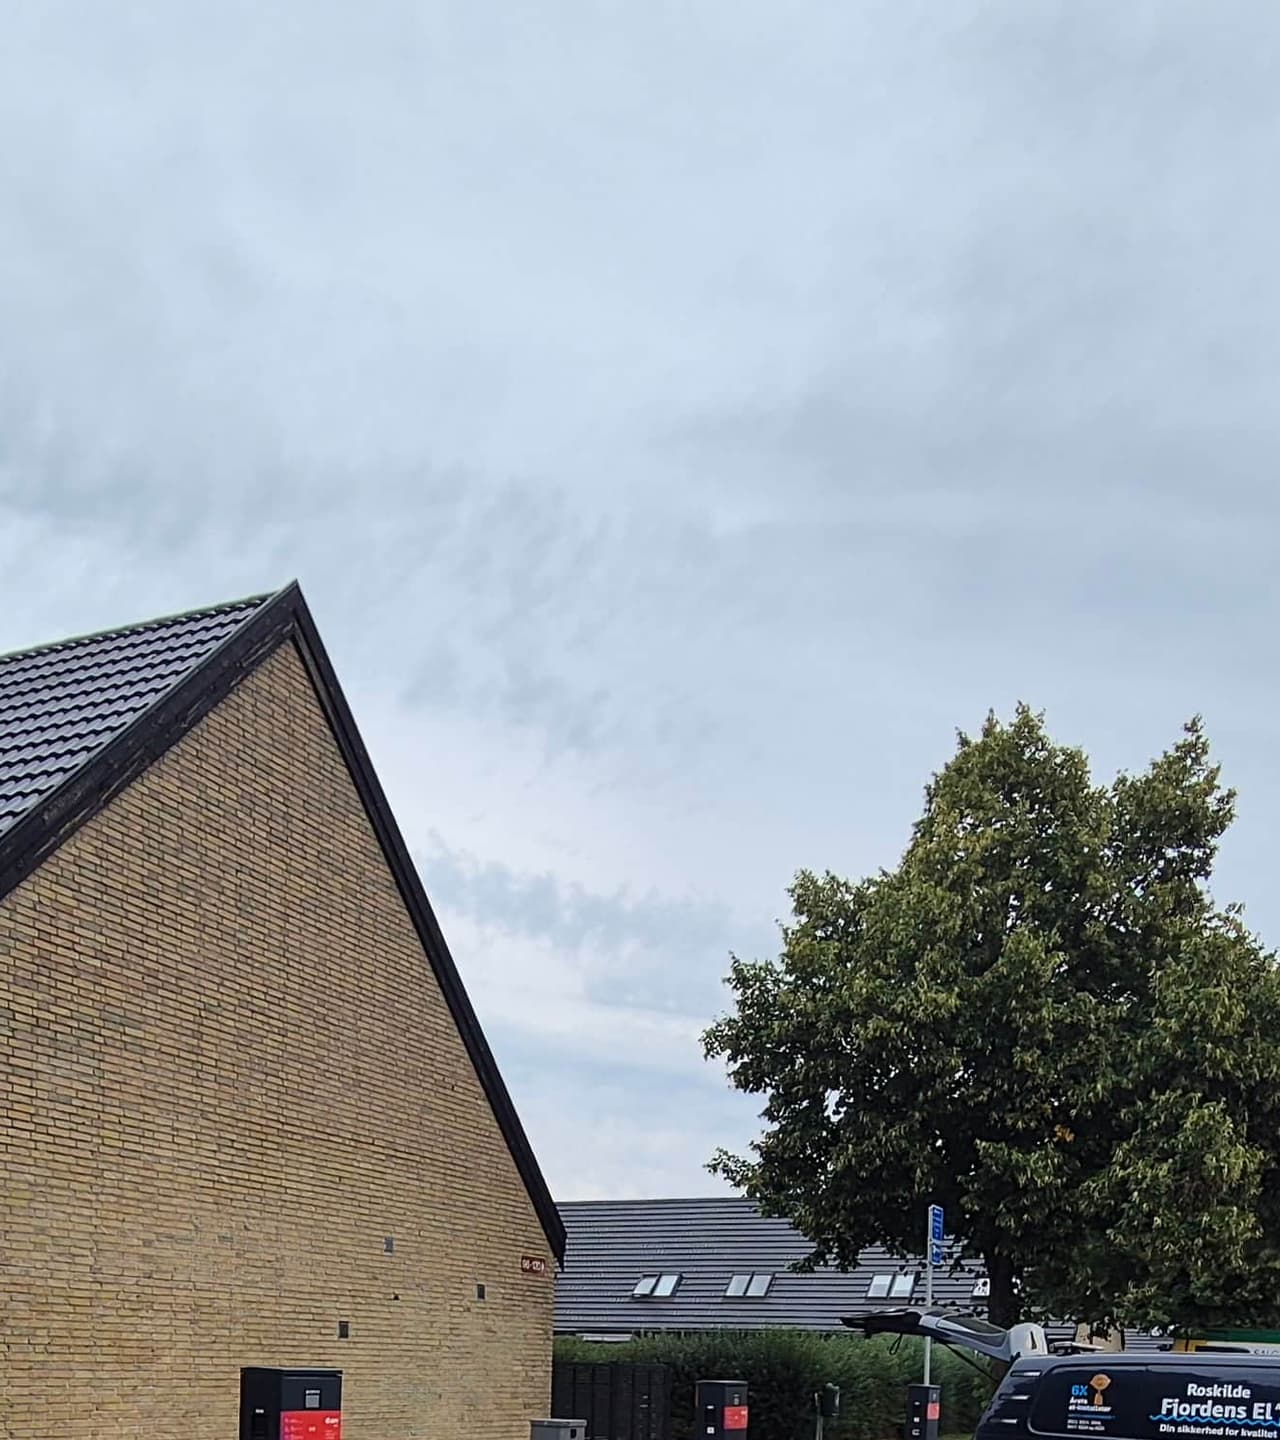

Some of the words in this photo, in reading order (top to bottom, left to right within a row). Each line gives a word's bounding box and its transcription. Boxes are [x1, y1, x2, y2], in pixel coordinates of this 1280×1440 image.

[1186, 1383, 1251, 1398] Roskilde
[1161, 1398, 1247, 1418] Fjordens
[1252, 1402, 1273, 1420] El
[1159, 1423, 1175, 1433] Din
[1177, 1424, 1223, 1436] sikkerhed
[1225, 1426, 1239, 1436] for
[1240, 1428, 1278, 1439] kvalitet
